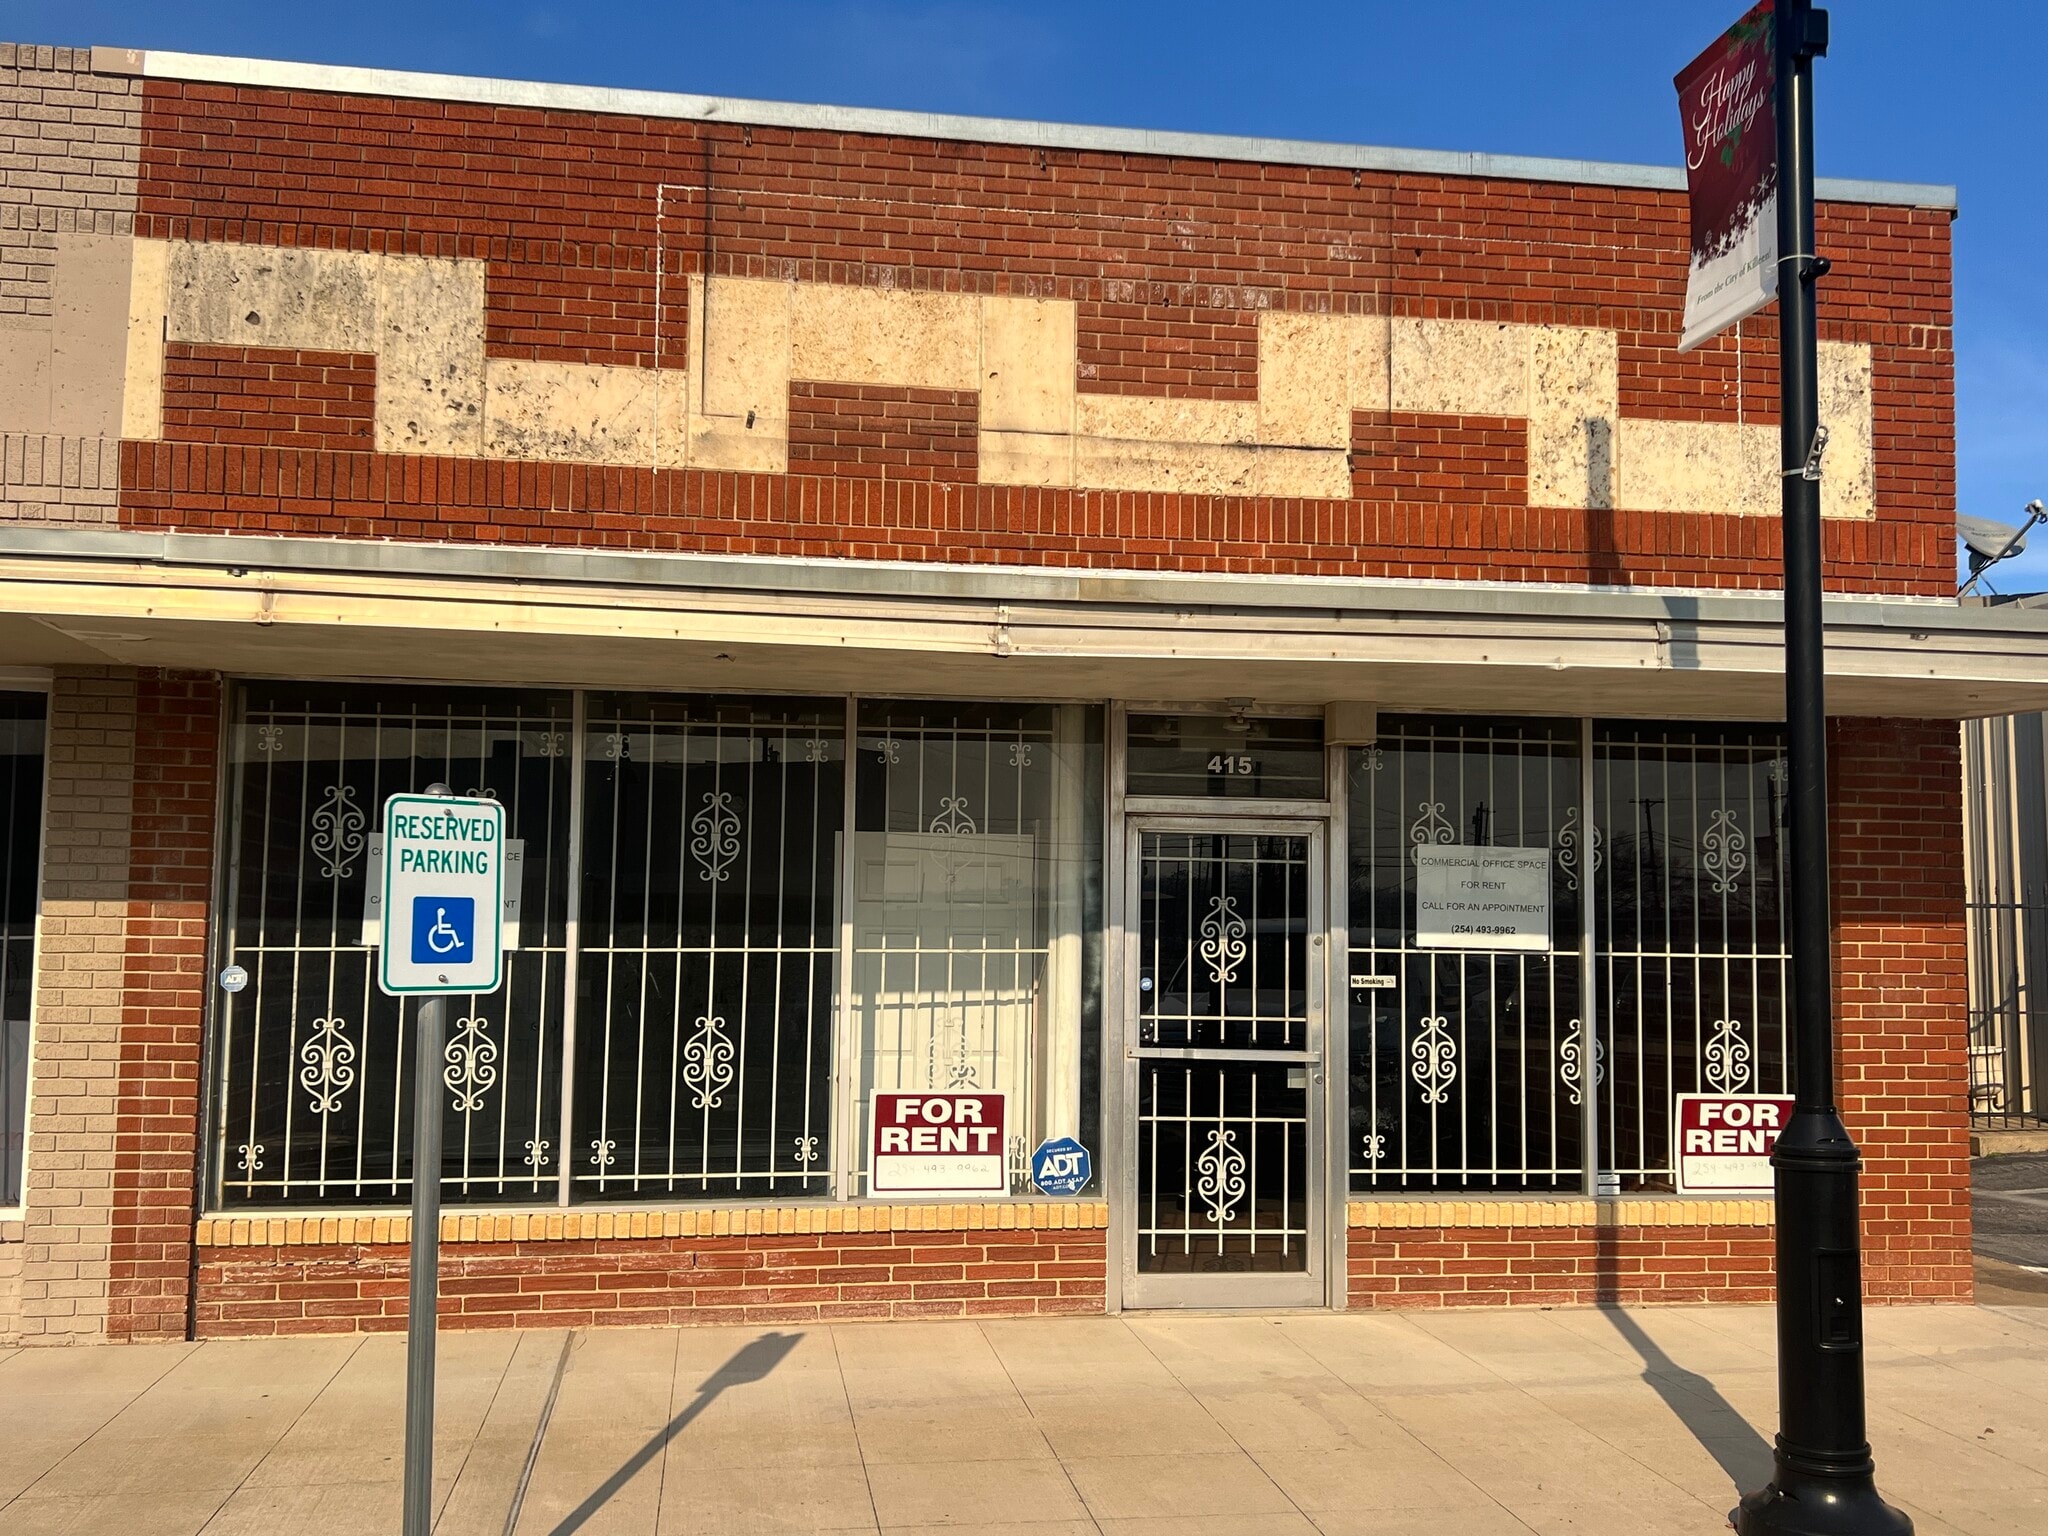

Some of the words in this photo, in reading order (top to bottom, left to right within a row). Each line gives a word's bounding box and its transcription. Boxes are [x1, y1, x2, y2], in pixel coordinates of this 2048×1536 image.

[1693, 59, 1757, 130] Happy
[1688, 86, 1766, 169] Holidays
[1697, 290, 1714, 304] From
[1714, 282, 1724, 294] the
[1725, 272, 1739, 286] City
[1739, 262, 1747, 277] of
[1207, 755, 1252, 774] 415
[394, 815, 495, 842] RESERVED
[401, 848, 489, 875] PARKING
[1421, 857, 1479, 868] COMMERCIAL
[1482, 859, 1515, 869] OFFICE
[1517, 860, 1547, 870] SPACE
[1461, 880, 1480, 889] FOR
[1482, 881, 1506, 890] RENT
[1422, 901, 1444, 911] CALL
[1446, 902, 1466, 911] FOR
[1467, 903, 1480, 912] AN
[1482, 903, 1545, 913] APPOINTMENT
[1451, 924, 1474, 935] (254)
[1475, 925, 1516, 935] 493-9962
[224, 974, 244, 984] ADT
[1351, 977, 1360, 985] No
[1360, 977, 1385, 987] Smoking
[896, 1098, 983, 1124] FOR
[1699, 1103, 1780, 1127] FOR
[880, 1127, 998, 1152] RENT
[1038, 1152, 1084, 1179] ADT
